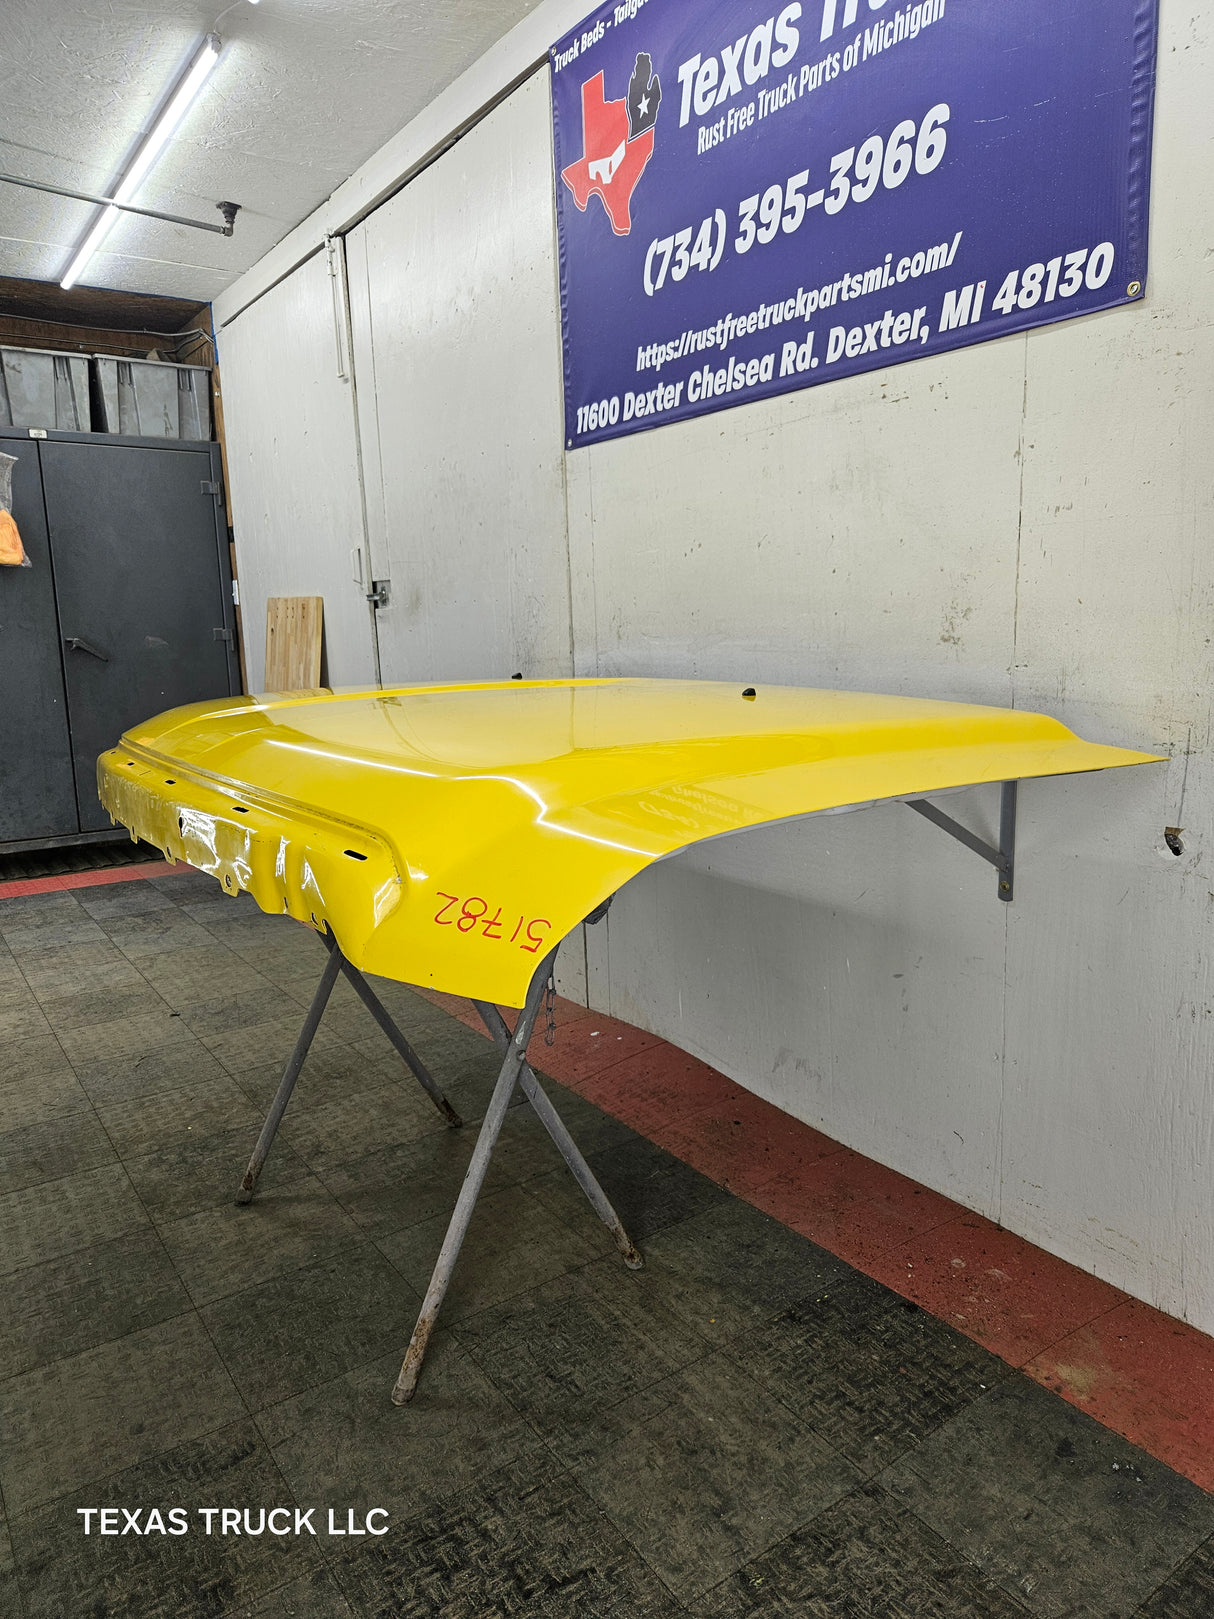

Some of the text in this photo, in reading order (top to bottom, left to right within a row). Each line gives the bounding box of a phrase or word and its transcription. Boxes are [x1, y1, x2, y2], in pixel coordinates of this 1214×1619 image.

[554, 38, 579, 73] Truck
[581, 20, 605, 53] Beds
[678, 2, 802, 128] Texas
[697, 116, 725, 155] Rust
[726, 101, 755, 139] Free
[757, 73, 797, 120] Truck
[799, 52, 841, 97] Parts
[842, 33, 862, 71] of
[643, 103, 950, 297] (734) 395-3966
[576, 241, 1115, 434] 11600 Dexter Chelsea Rd. Dexter, MI 48130
[636, 231, 963, 372] https://rustfreetruckpartsmi.com/
[434, 892, 552, 954] 51782
